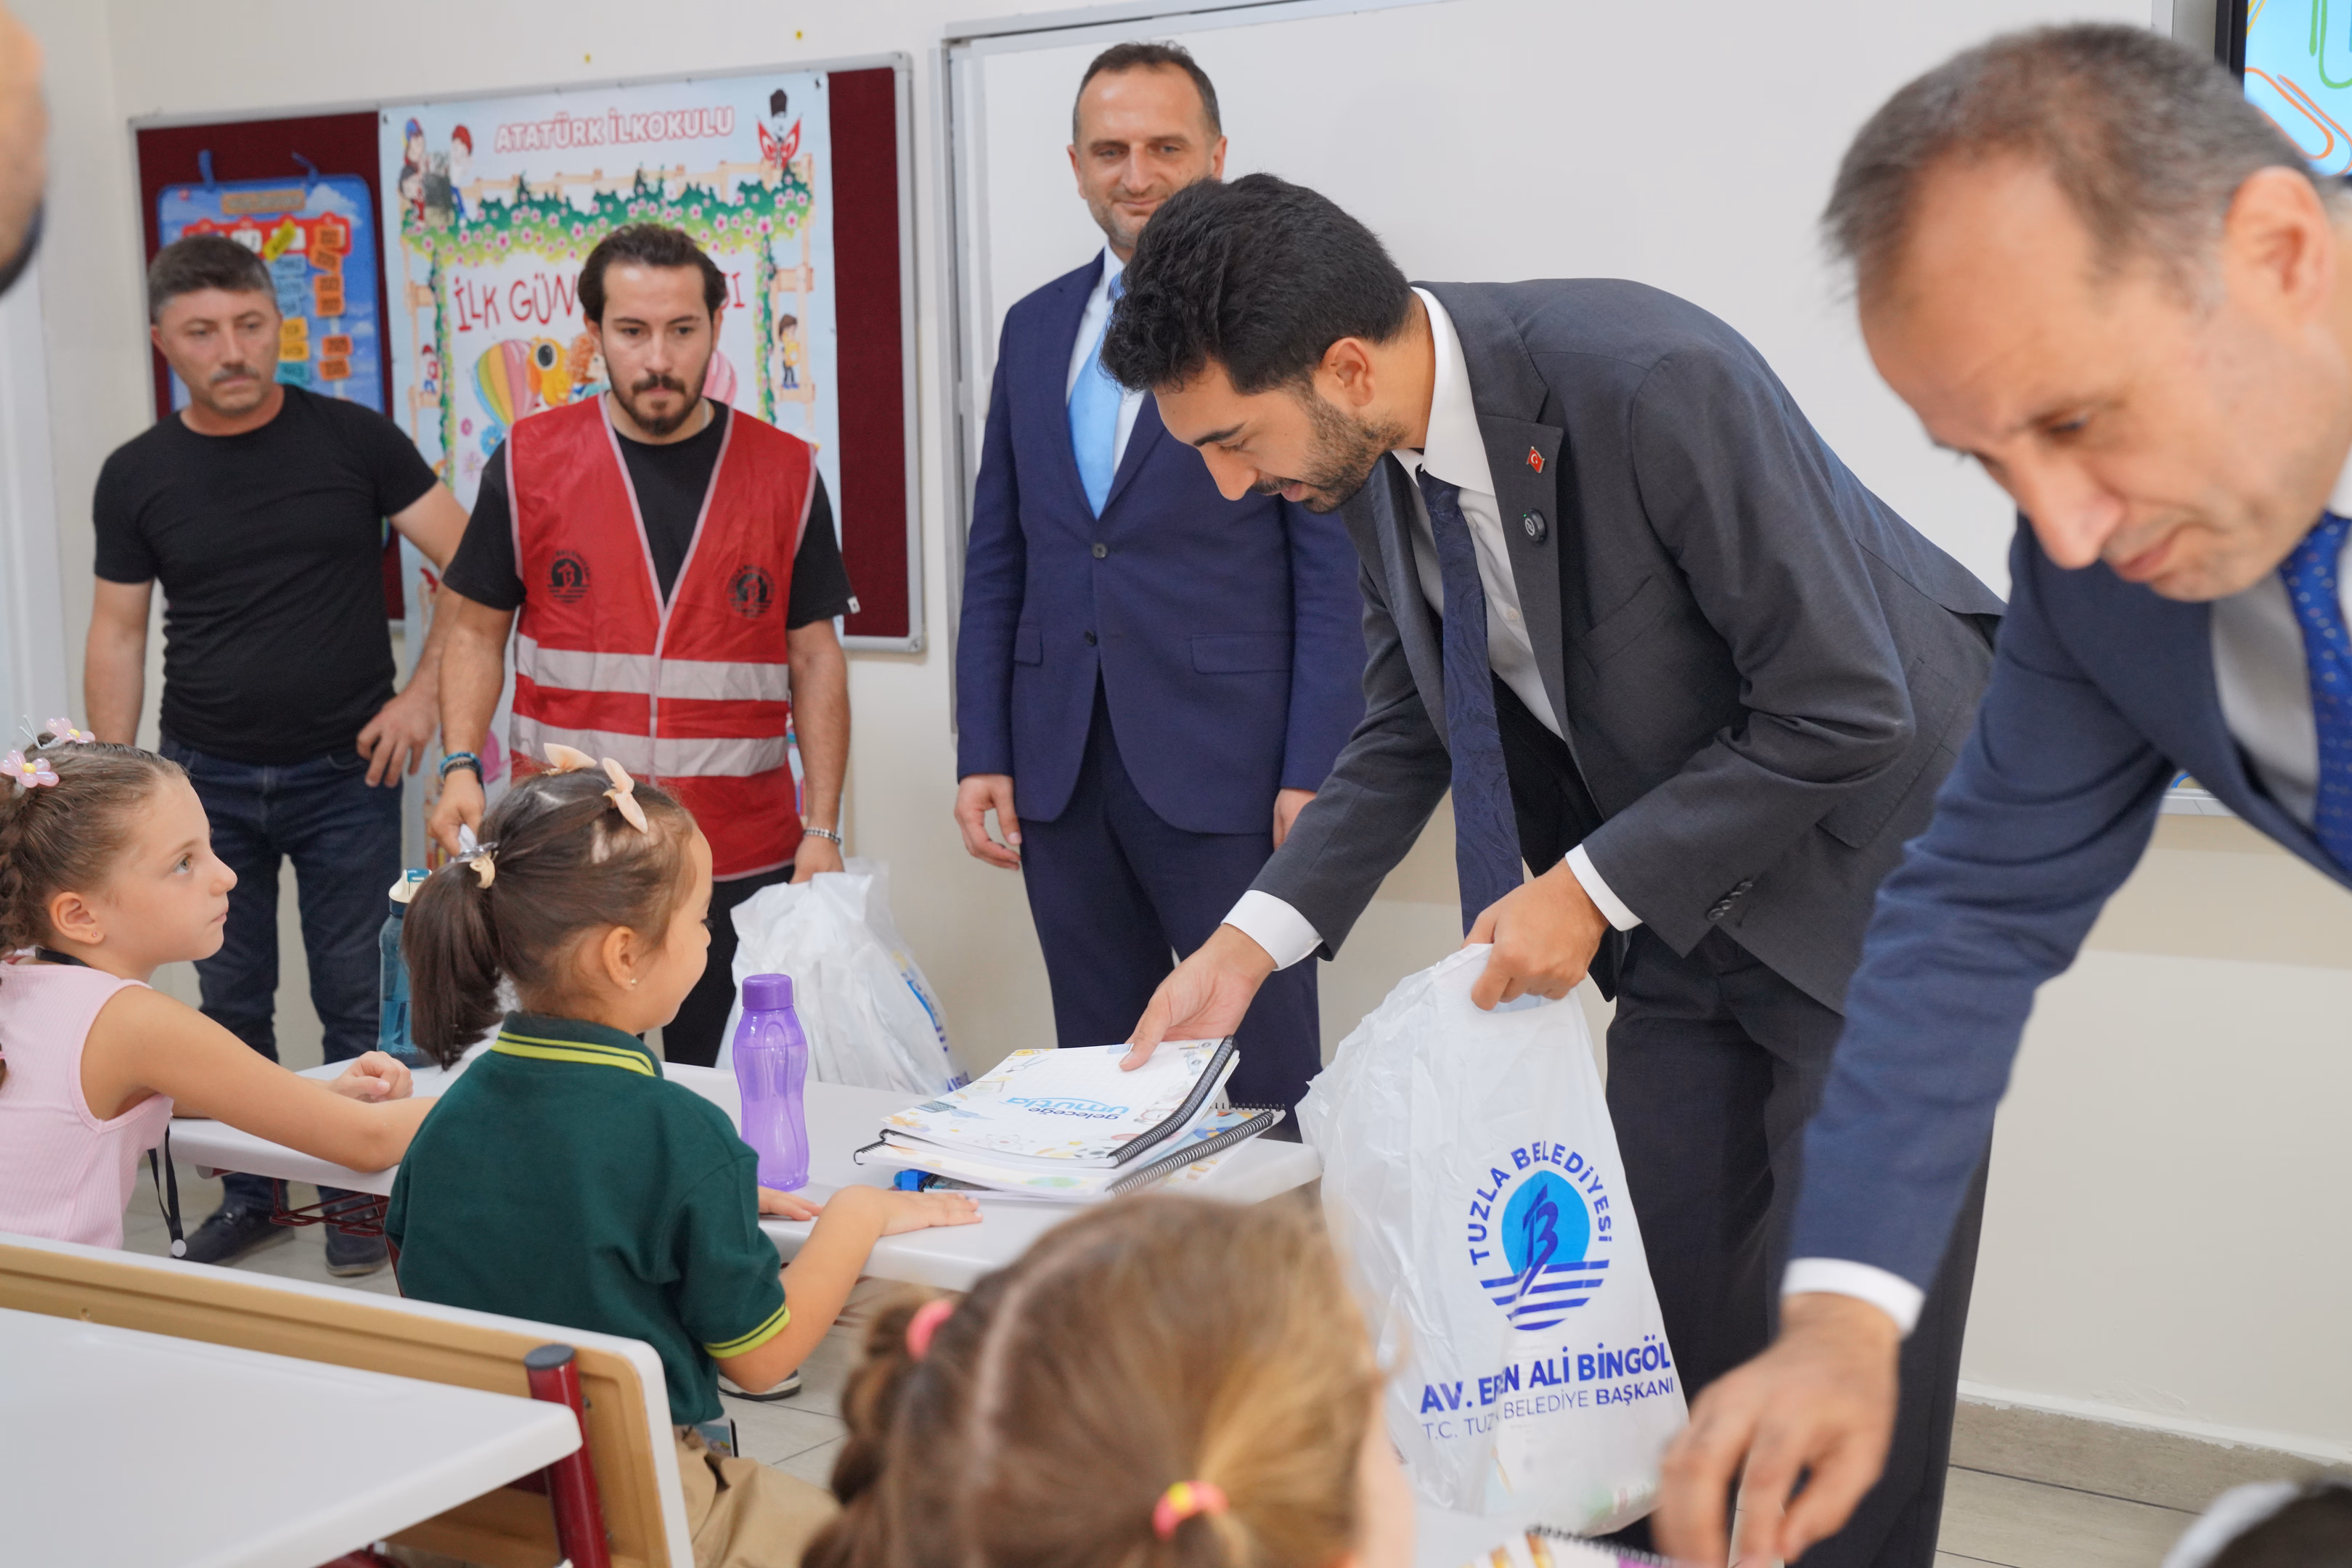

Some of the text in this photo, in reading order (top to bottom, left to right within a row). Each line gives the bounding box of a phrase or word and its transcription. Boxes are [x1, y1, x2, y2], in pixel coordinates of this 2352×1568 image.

[494, 107, 735, 153] ATATÜRK İLKOKULU
[454, 271, 577, 332] İLK GÜN
[1467, 1140, 1612, 1266] TUZLA BELEDİYESİ
[1420, 1381, 1472, 1414] AV.
[1529, 1346, 1569, 1389] ALİ
[1577, 1334, 1670, 1381] BİNGÖL
[1422, 1421, 1458, 1440] T.C.
[1504, 1389, 1589, 1419] BELEDİYE
[1596, 1376, 1674, 1406] BAŞKANI
